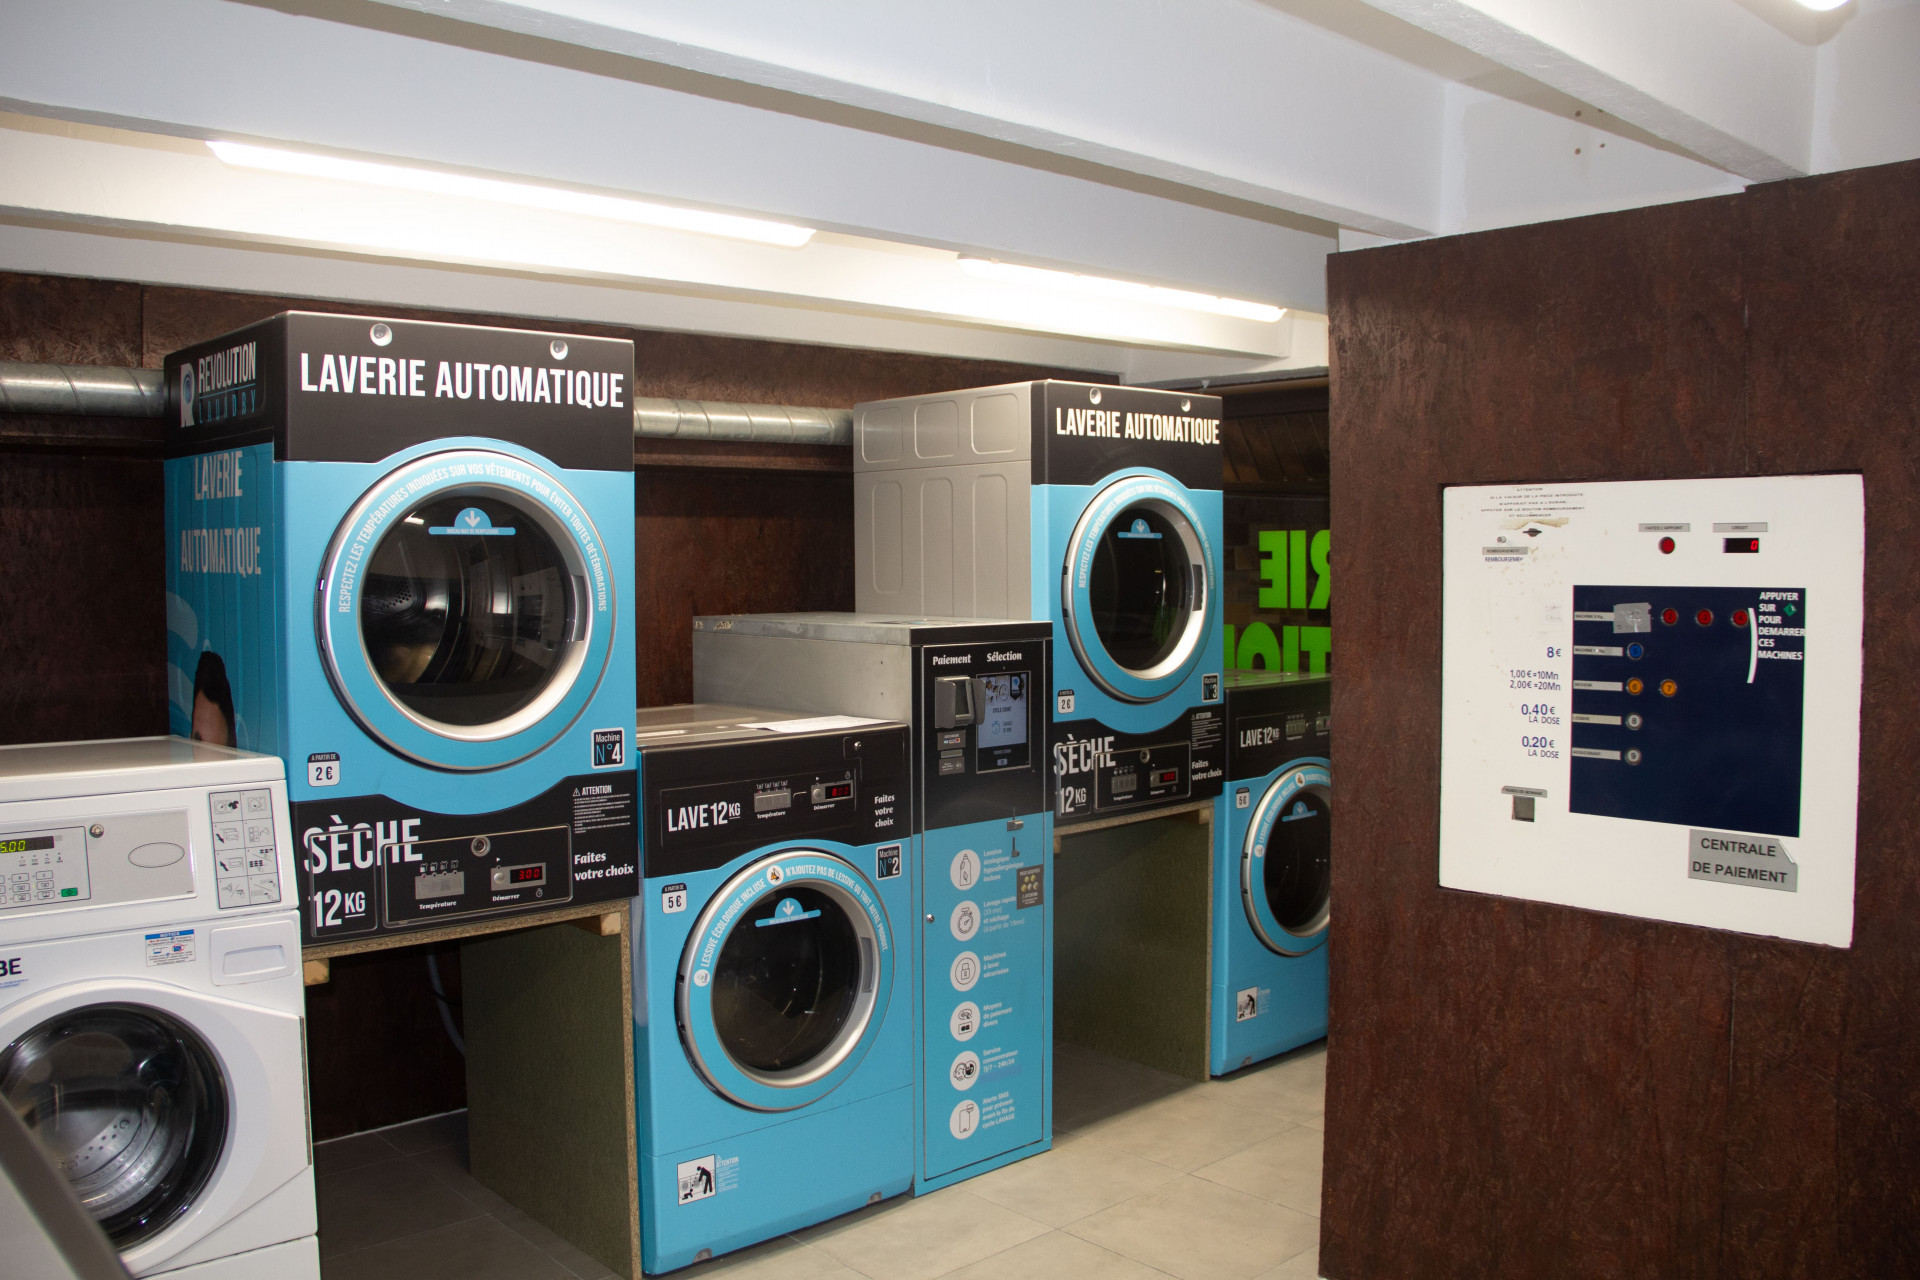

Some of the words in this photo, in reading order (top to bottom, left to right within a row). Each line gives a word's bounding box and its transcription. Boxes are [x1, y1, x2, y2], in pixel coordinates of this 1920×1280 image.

[198, 341, 256, 394] REVOLUTION
[300, 352, 426, 397] LAVERIE
[435, 361, 624, 408] AUTOMATIQUE
[1056, 407, 1121, 438] LAVERIE
[1124, 412, 1220, 446] AUTOMATIQUE
[195, 450, 243, 501] LAVERIE
[338, 560, 357, 613] RESPECTEZ
[348, 541, 364, 562] LES
[357, 487, 409, 545] TEMPÉRATURES
[405, 467, 449, 494] INDIQUÉES
[448, 463, 467, 478] SUR
[467, 463, 484, 475] VOS
[484, 462, 531, 486] VÊTEMENTS
[530, 478, 550, 498] POUR
[549, 491, 573, 518] ÉVITER
[569, 513, 591, 545] TOUTES
[585, 543, 607, 612] DÉTÉRIORATIONS
[181, 527, 262, 578] AUTOMATIQUE
[1759, 591, 1799, 601] APPUYER
[1758, 603, 1776, 612] SUR
[1758, 615, 1782, 624] POUR
[1758, 626, 1806, 637] DEMARRER
[1758, 638, 1775, 647] CES
[932, 654, 972, 666] Paiement
[986, 651, 1022, 662] Sélection
[1757, 650, 1803, 660] MACHINES
[1528, 715, 1539, 723] LA
[1541, 716, 1560, 725] DOSE
[595, 733, 621, 743] Machine
[1240, 728, 1263, 748] LAVE
[1053, 733, 1116, 776] SÈCHE
[1527, 749, 1538, 757] LA
[1540, 749, 1559, 759] DOSE
[1191, 760, 1209, 770] Faites
[1192, 771, 1207, 781] votre
[1207, 768, 1223, 777] choix
[581, 784, 612, 796] ATTENTION
[874, 794, 895, 805] Faites
[874, 806, 894, 816] votre
[667, 803, 709, 832] LAVE
[874, 817, 894, 828] choix
[302, 814, 423, 874] SÈCHE
[1700, 837, 1776, 857] CENTRALE
[573, 852, 607, 865] Faites
[879, 848, 899, 859] Machine
[574, 868, 604, 881] votre
[605, 864, 634, 877] choix
[1692, 861, 1711, 873] DE
[1714, 863, 1788, 883] PAIEMENT
[785, 865, 816, 877] N'AJOUTEZ
[816, 865, 827, 876] PAS
[827, 868, 836, 878] DE
[835, 871, 856, 890] LESSIVE
[853, 883, 862, 894] OU
[492, 893, 520, 901] Démarrer
[419, 900, 457, 910] Température
[700, 937, 719, 968] LESSIVE
[711, 898, 744, 939] ÉCOLOGIQUE
[740, 878, 767, 902] INCLUSE
